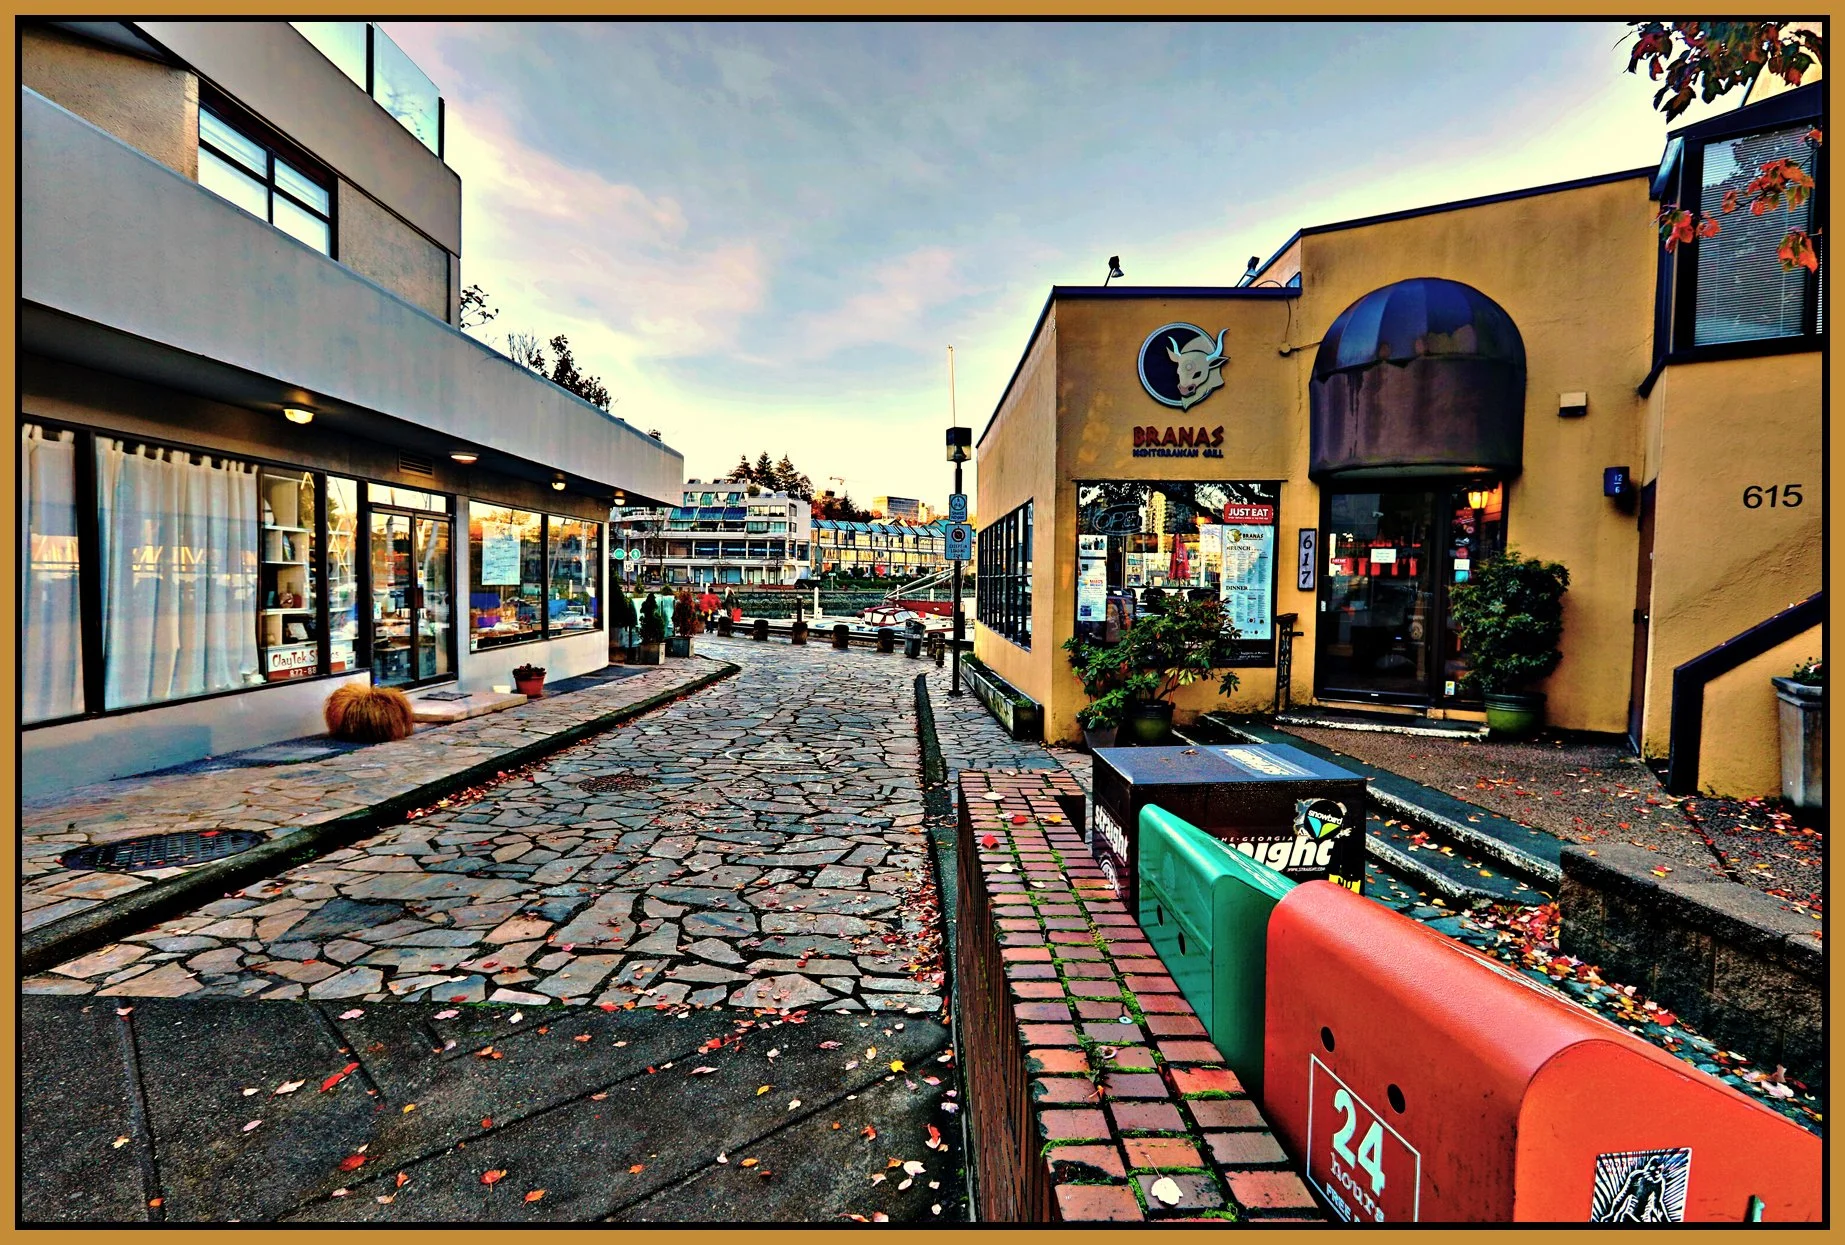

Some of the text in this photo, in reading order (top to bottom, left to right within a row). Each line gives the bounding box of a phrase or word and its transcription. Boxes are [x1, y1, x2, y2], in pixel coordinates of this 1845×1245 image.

[1133, 425, 1224, 448] BRANAS
[1132, 448, 1224, 459] MEDITERRANEAN GRILL
[1614, 473, 1623, 482] 12
[1614, 486, 1621, 494] 6
[1742, 483, 1804, 509] 615
[1228, 508, 1269, 517] JUST EAT
[1301, 534, 1313, 585] 617
[272, 651, 307, 668] ClayTek
[1307, 809, 1343, 825] snowbird
[1094, 804, 1129, 863] straight
[1333, 1089, 1385, 1197] 24
[1330, 1151, 1385, 1222] hours
[1326, 1182, 1351, 1221] FREE
